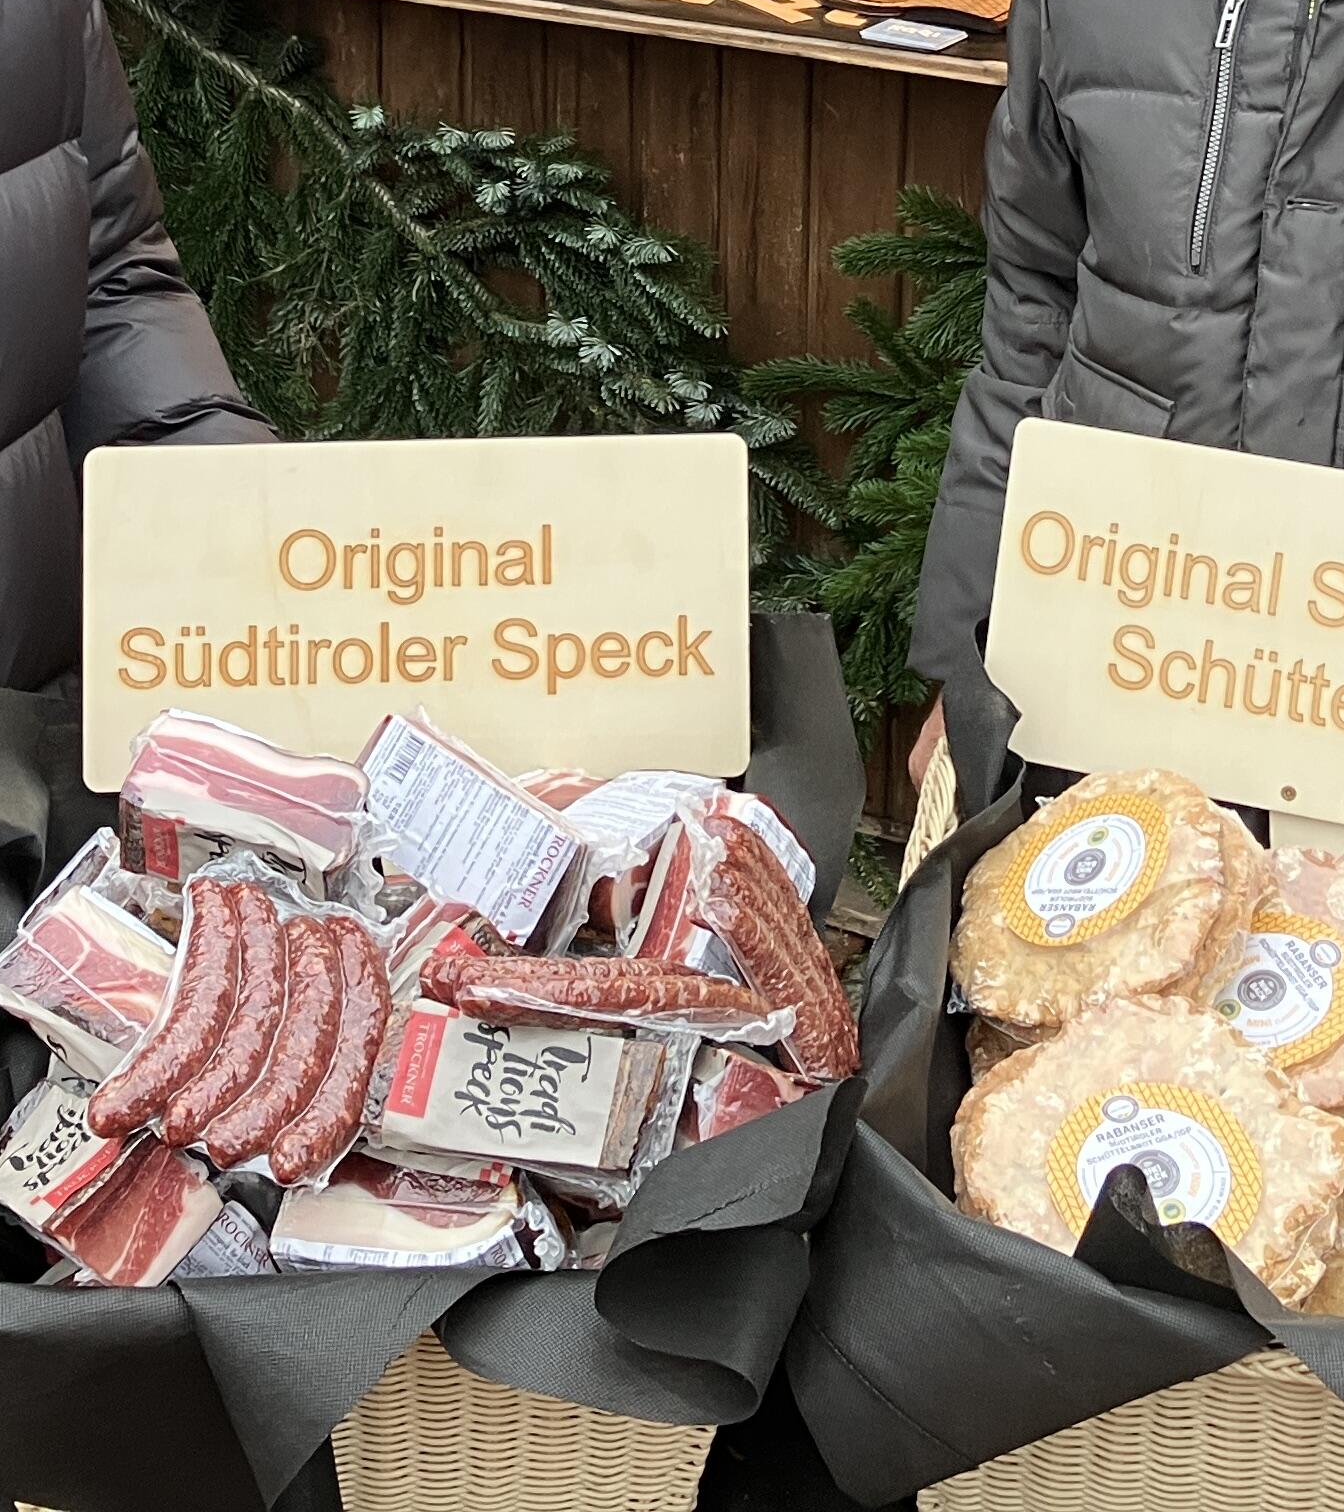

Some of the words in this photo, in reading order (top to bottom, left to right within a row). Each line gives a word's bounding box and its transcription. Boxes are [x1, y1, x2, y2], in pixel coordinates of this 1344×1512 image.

[279, 523, 553, 605] Original
[1020, 510, 1284, 609] Original
[117, 621, 468, 688] Südtiroler
[491, 614, 715, 696] Speck
[1039, 902, 1097, 912] RABANSER
[1284, 939, 1328, 990] RABANSER
[400, 1023, 429, 1105] TROCKNER
[1095, 1113, 1166, 1143] RABANSER
